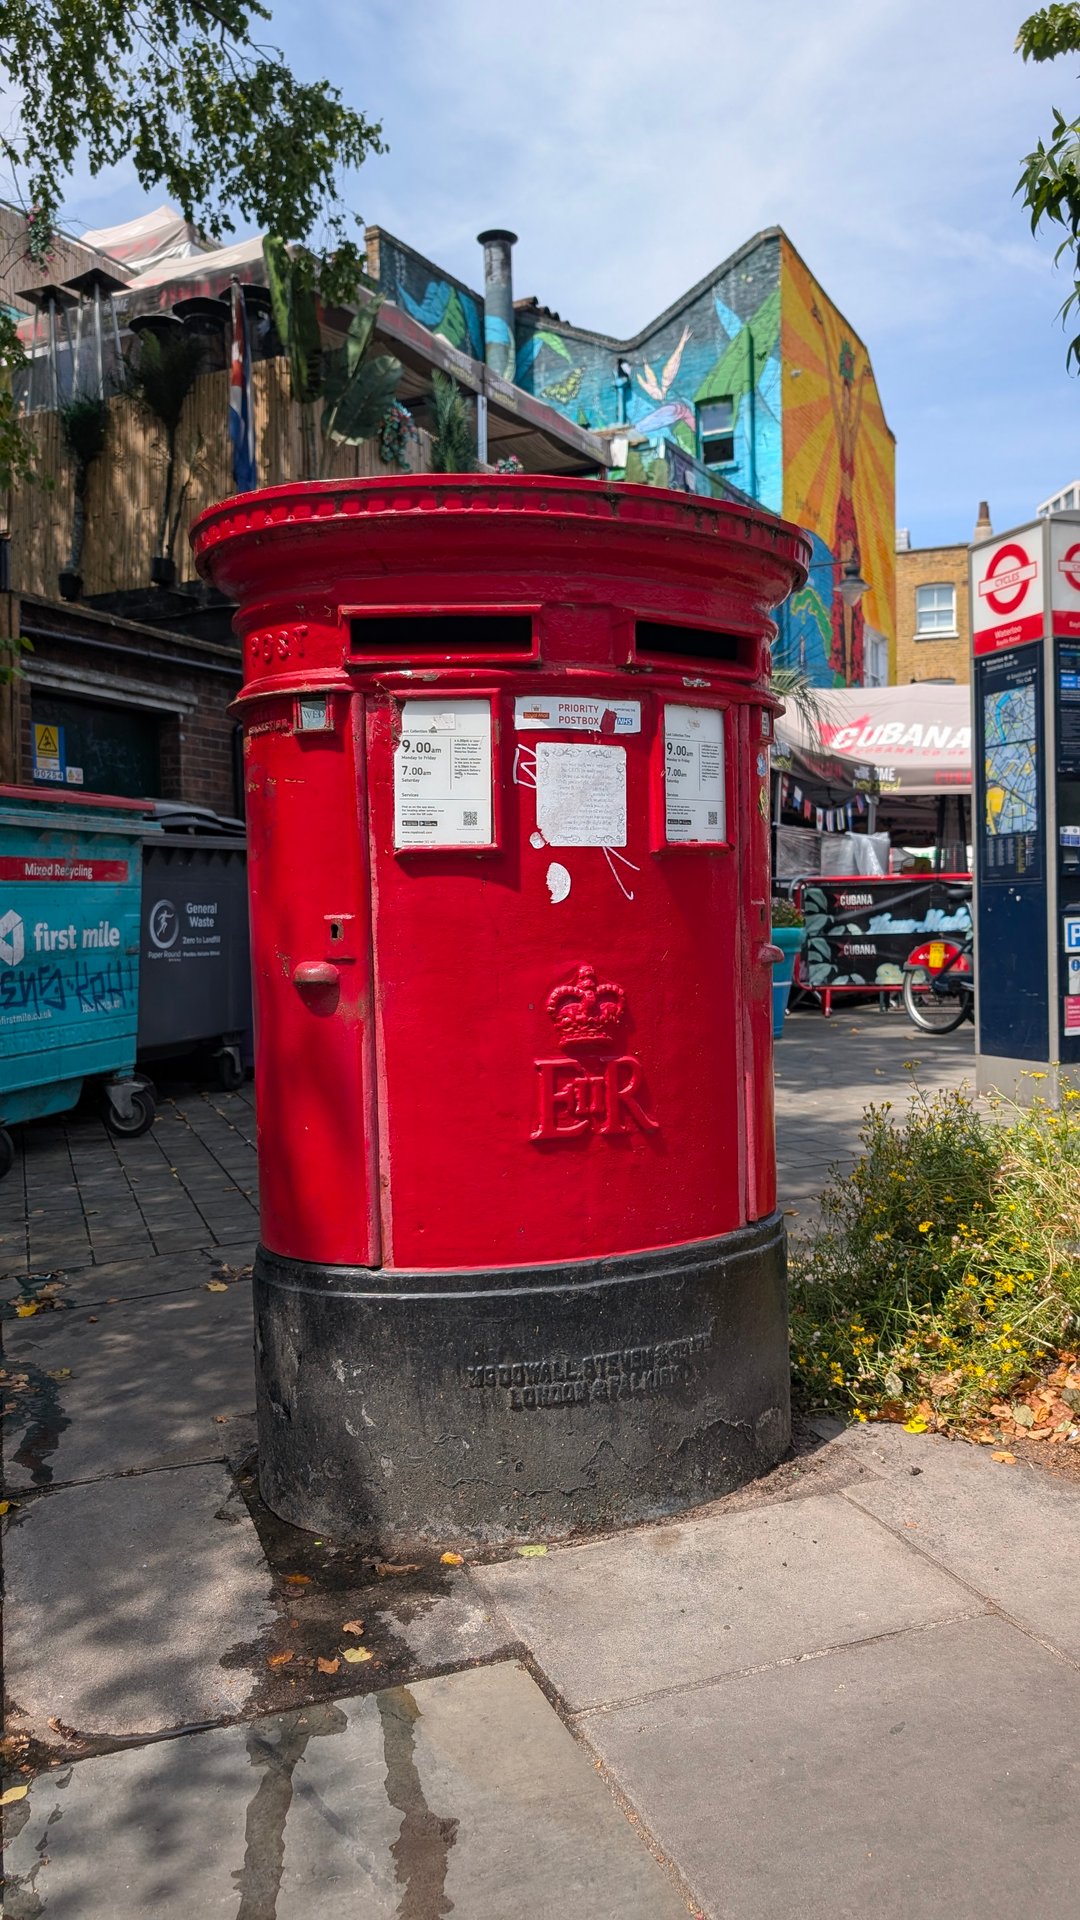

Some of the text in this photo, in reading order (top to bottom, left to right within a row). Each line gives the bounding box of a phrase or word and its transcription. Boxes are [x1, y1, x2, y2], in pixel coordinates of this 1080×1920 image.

[995, 571, 1020, 587] CYCLES
[250, 623, 309, 664] POST
[558, 703, 599, 713] PRIORITY
[303, 710, 325, 719] WED
[558, 716, 599, 725] POSTBOX
[831, 720, 972, 749] CUBANA
[402, 739, 441, 753] 9.00am
[667, 742, 693, 756] 9.00am
[402, 766, 431, 775] 7.00am
[666, 766, 687, 777] 7.00am
[25, 863, 93, 879] Mixed Recycling
[840, 894, 873, 906] CUBANA
[186, 902, 218, 914] General
[189, 917, 215, 927] Waste
[34, 921, 120, 951] first mile
[182, 936, 195, 944] Zero
[844, 944, 876, 955] CUBANA
